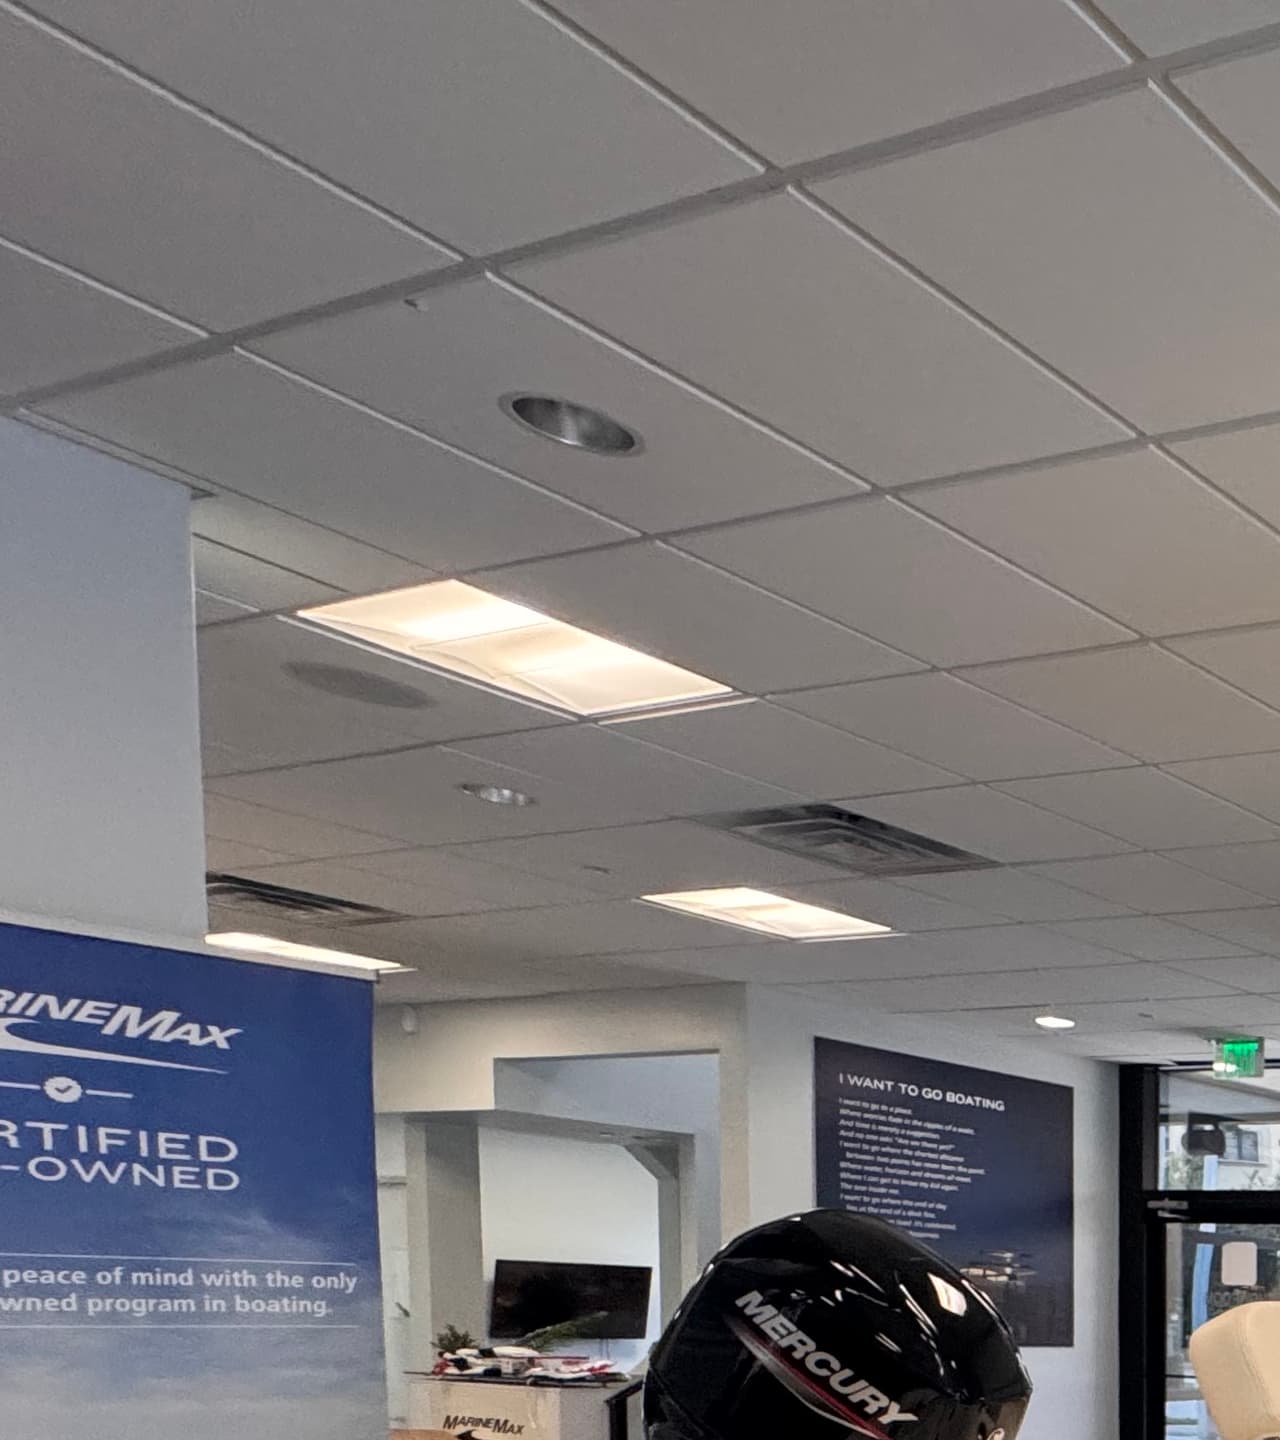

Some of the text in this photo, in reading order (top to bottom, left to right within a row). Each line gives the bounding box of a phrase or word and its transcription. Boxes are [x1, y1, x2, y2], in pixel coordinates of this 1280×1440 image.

[839, 1072, 1005, 1112] I WANT TO GO BOATING
[2, 1266, 358, 1294] peace of mind with the only
[0, 1292, 333, 1317] wned program in boating.
[735, 1290, 919, 1426] MERCURY
